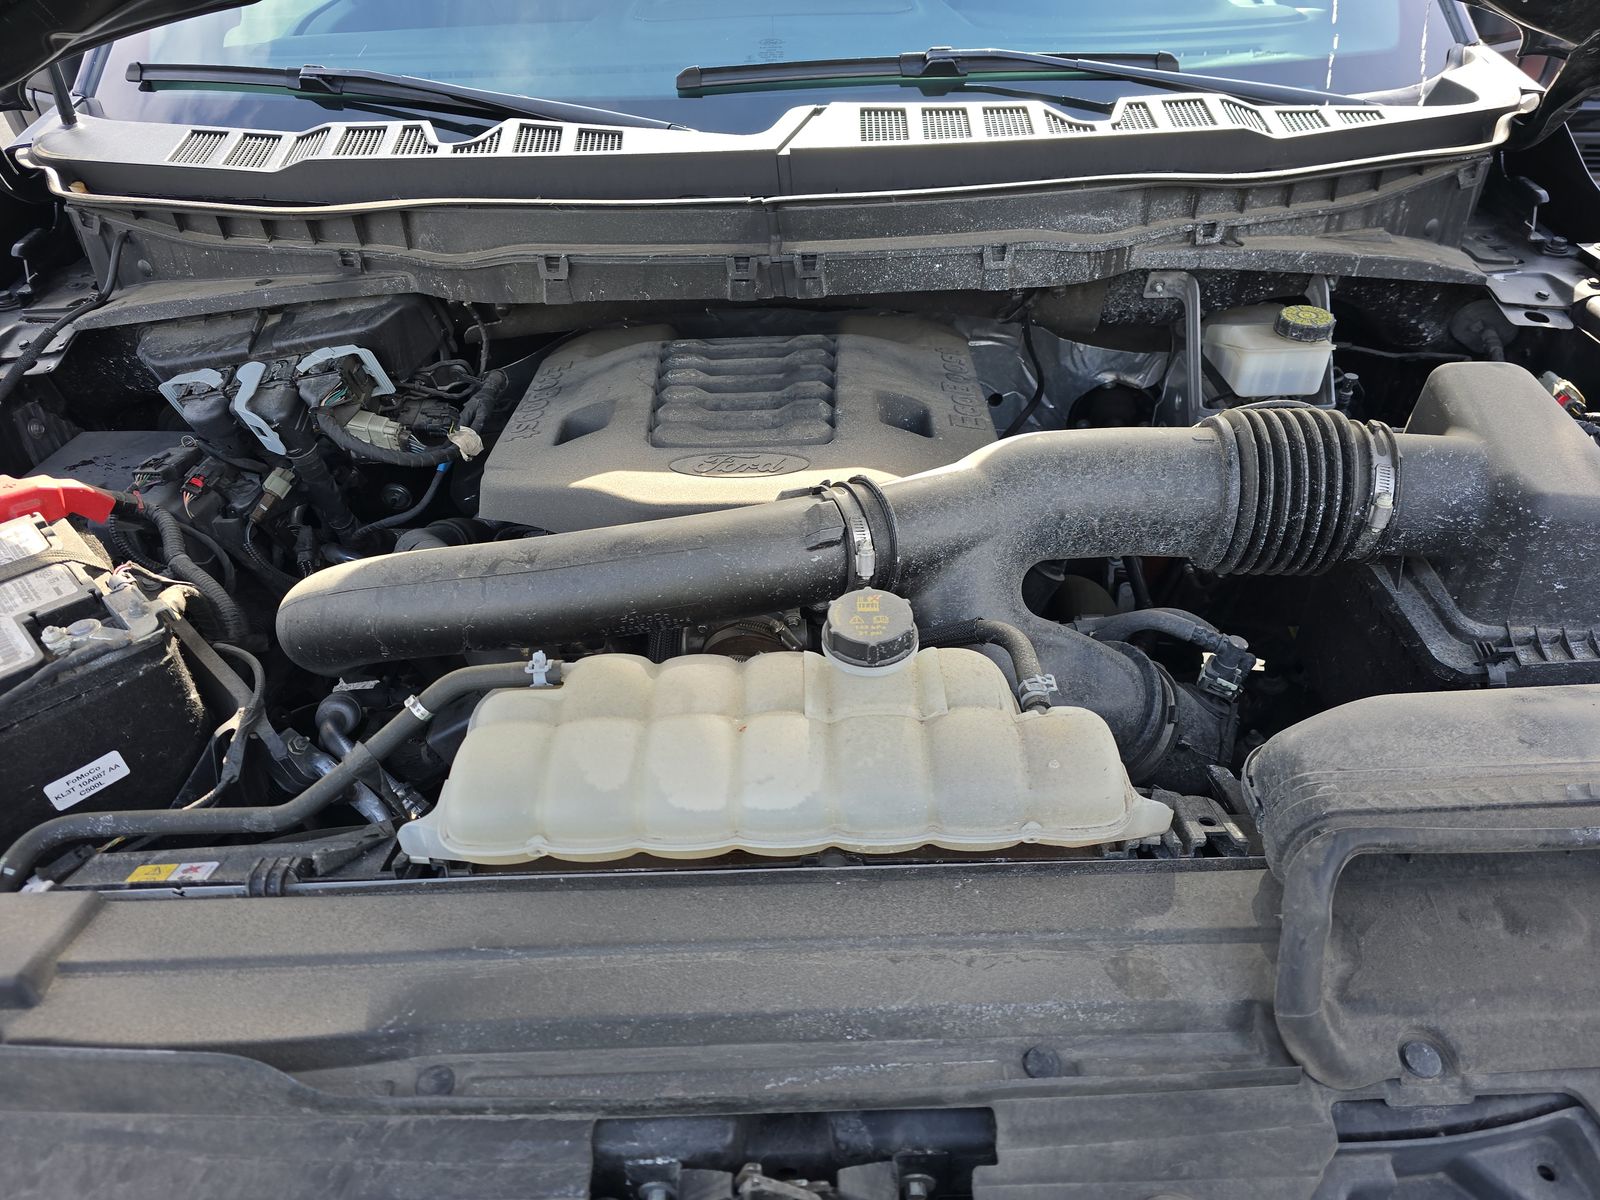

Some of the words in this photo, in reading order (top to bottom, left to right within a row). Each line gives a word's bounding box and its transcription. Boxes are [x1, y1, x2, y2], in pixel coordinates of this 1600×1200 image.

[693, 454, 787, 474] Ford
[54, 786, 77, 801] KL3T
[108, 763, 121, 773] AA
[65, 765, 101, 787] FoMoCo
